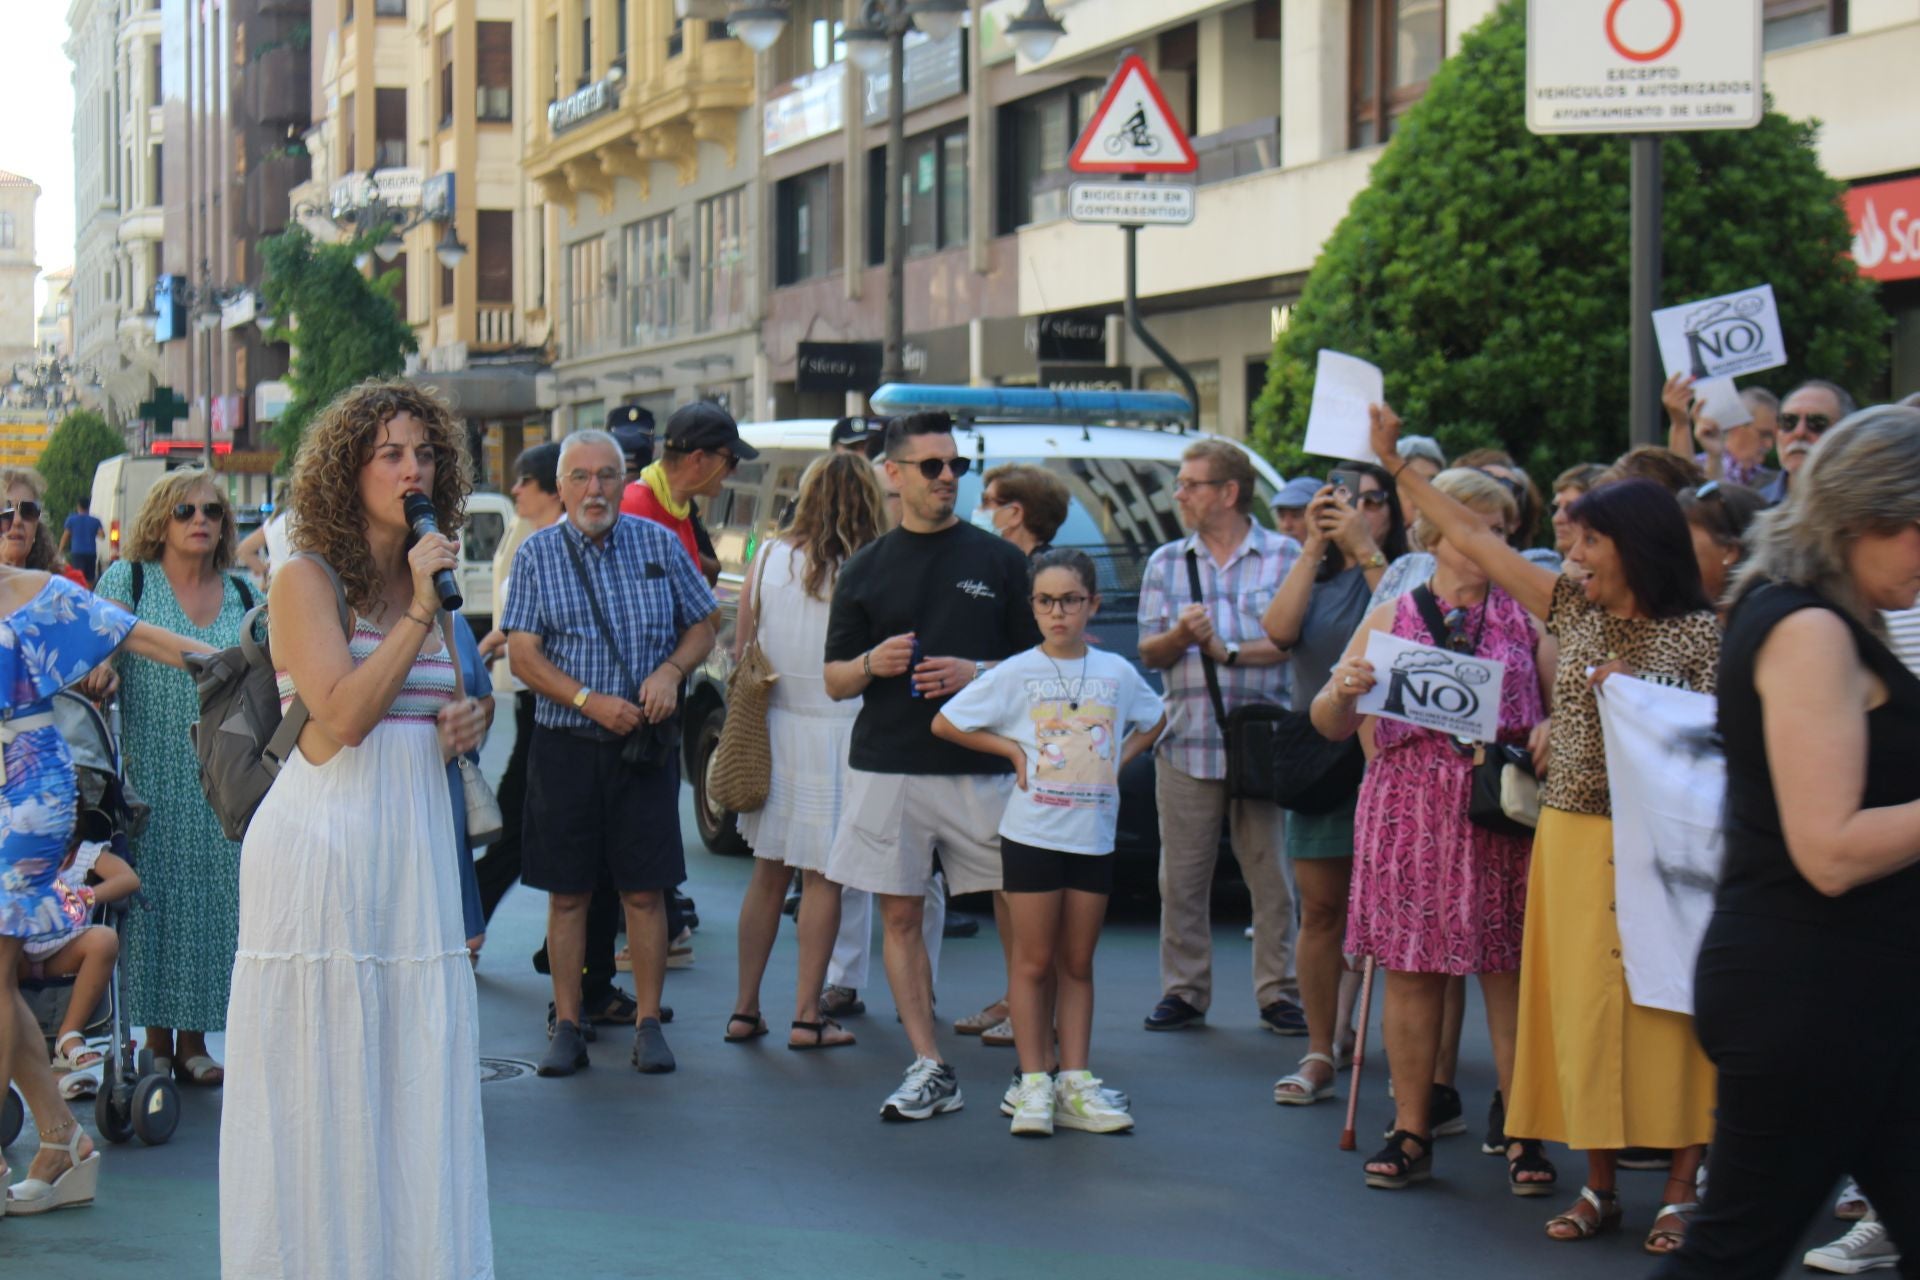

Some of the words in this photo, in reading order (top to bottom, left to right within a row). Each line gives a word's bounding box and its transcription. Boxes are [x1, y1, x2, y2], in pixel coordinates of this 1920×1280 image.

[1606, 67, 1680, 81] EXCEPTO
[1536, 84, 1626, 99] VEHÍCULOS
[1636, 81, 1752, 97] AUTORIZADOS
[1552, 104, 1664, 119] AYUNTAMIENTO
[1670, 104, 1689, 116] DE
[1081, 190, 1157, 201] BICICLETAS
[1163, 191, 1182, 202] EN
[1075, 204, 1187, 217] CONTRASENTIDO
[1686, 325, 1755, 372] NO
[1382, 668, 1469, 716] NO
